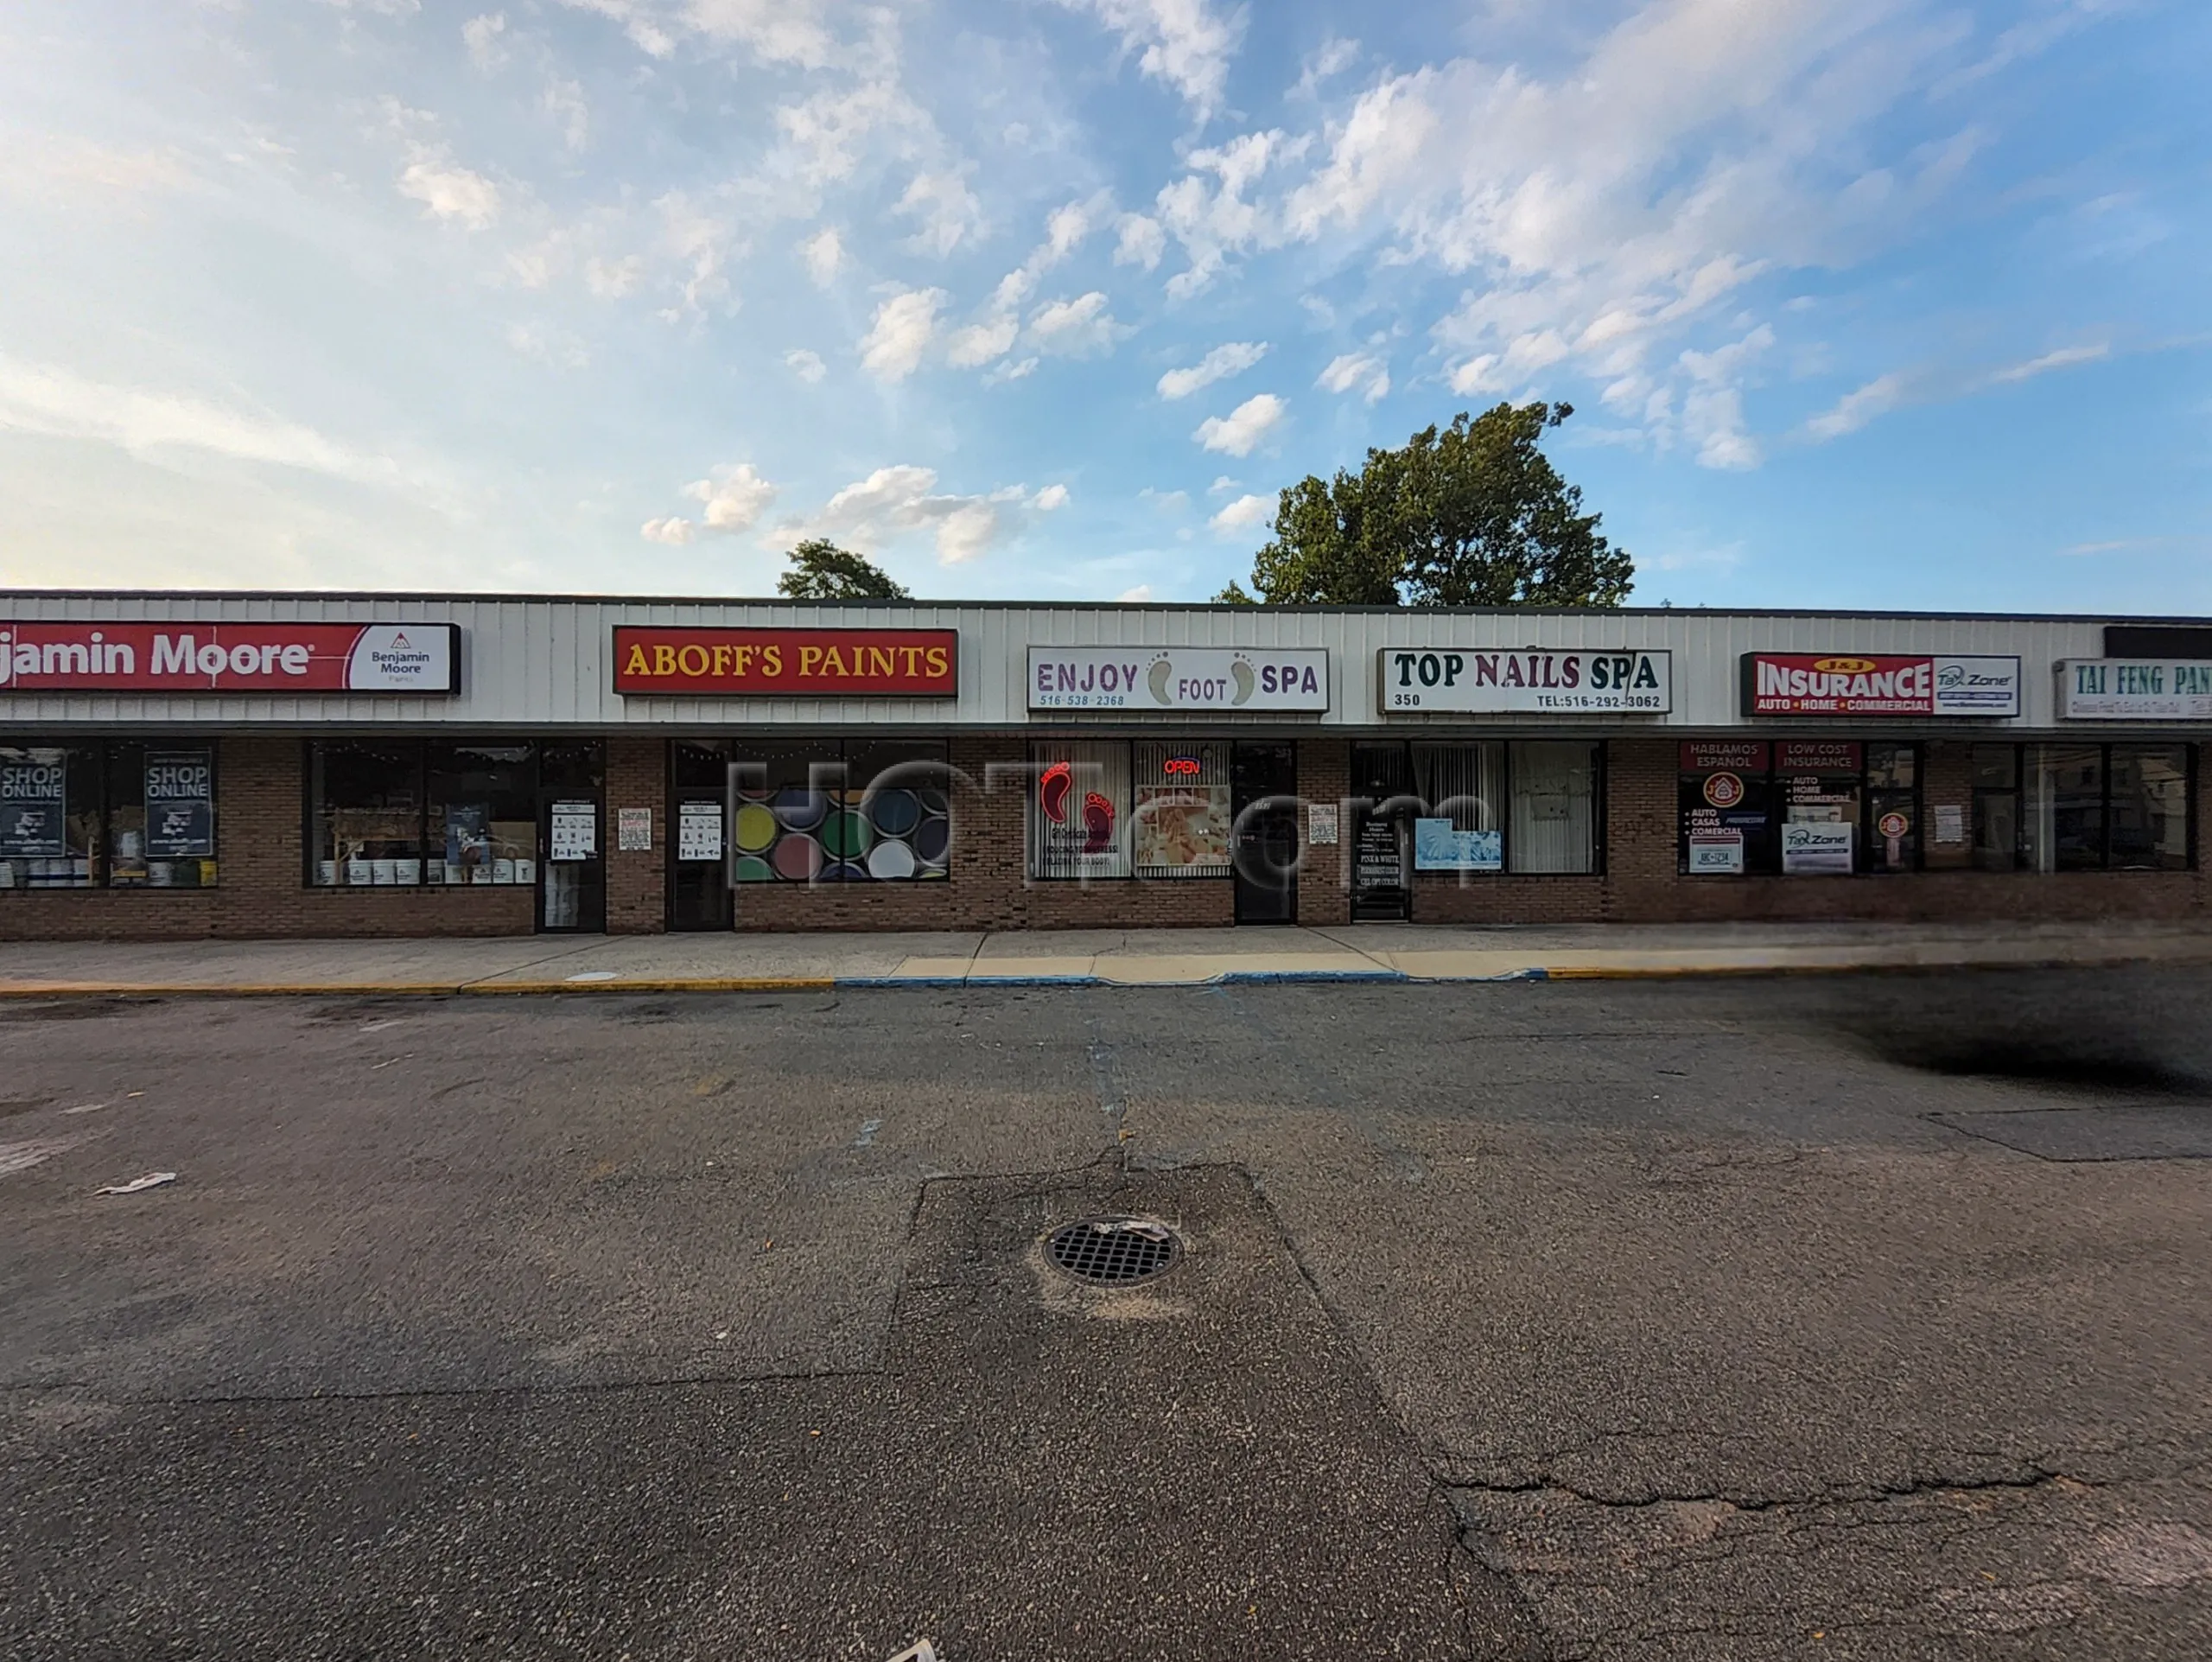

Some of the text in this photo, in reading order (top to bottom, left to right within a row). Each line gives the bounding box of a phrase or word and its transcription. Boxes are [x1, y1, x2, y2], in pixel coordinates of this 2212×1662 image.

[372, 652, 430, 664] Benjamin
[623, 644, 949, 678] ABOFF'S PAINTS
[380, 663, 422, 673] Moore
[1395, 653, 1659, 690] TOP NAILS SPA
[1824, 660, 1865, 671] J&J
[1038, 664, 1319, 701] ENJOY FOOT SPA
[1757, 661, 1930, 699] INSURANCE
[2075, 665, 2107, 694] TAI
[2116, 665, 2164, 694] FENG
[1395, 694, 1660, 708] 350 TEL:516-292-3062
[1758, 699, 1790, 710] AUTO
[1801, 699, 1838, 710] HOME
[1847, 699, 1931, 711] COMMERCIAL
[1690, 744, 1758, 755] HABLAMOS
[1788, 744, 1847, 755] LOW COST
[1165, 761, 1200, 774] OPEN
[1783, 757, 1852, 767] INSURANCE
[3, 767, 63, 784] SHOP
[148, 767, 208, 784] SHOP
[2, 784, 63, 797] ONLINE
[148, 783, 208, 797] ONLINE
